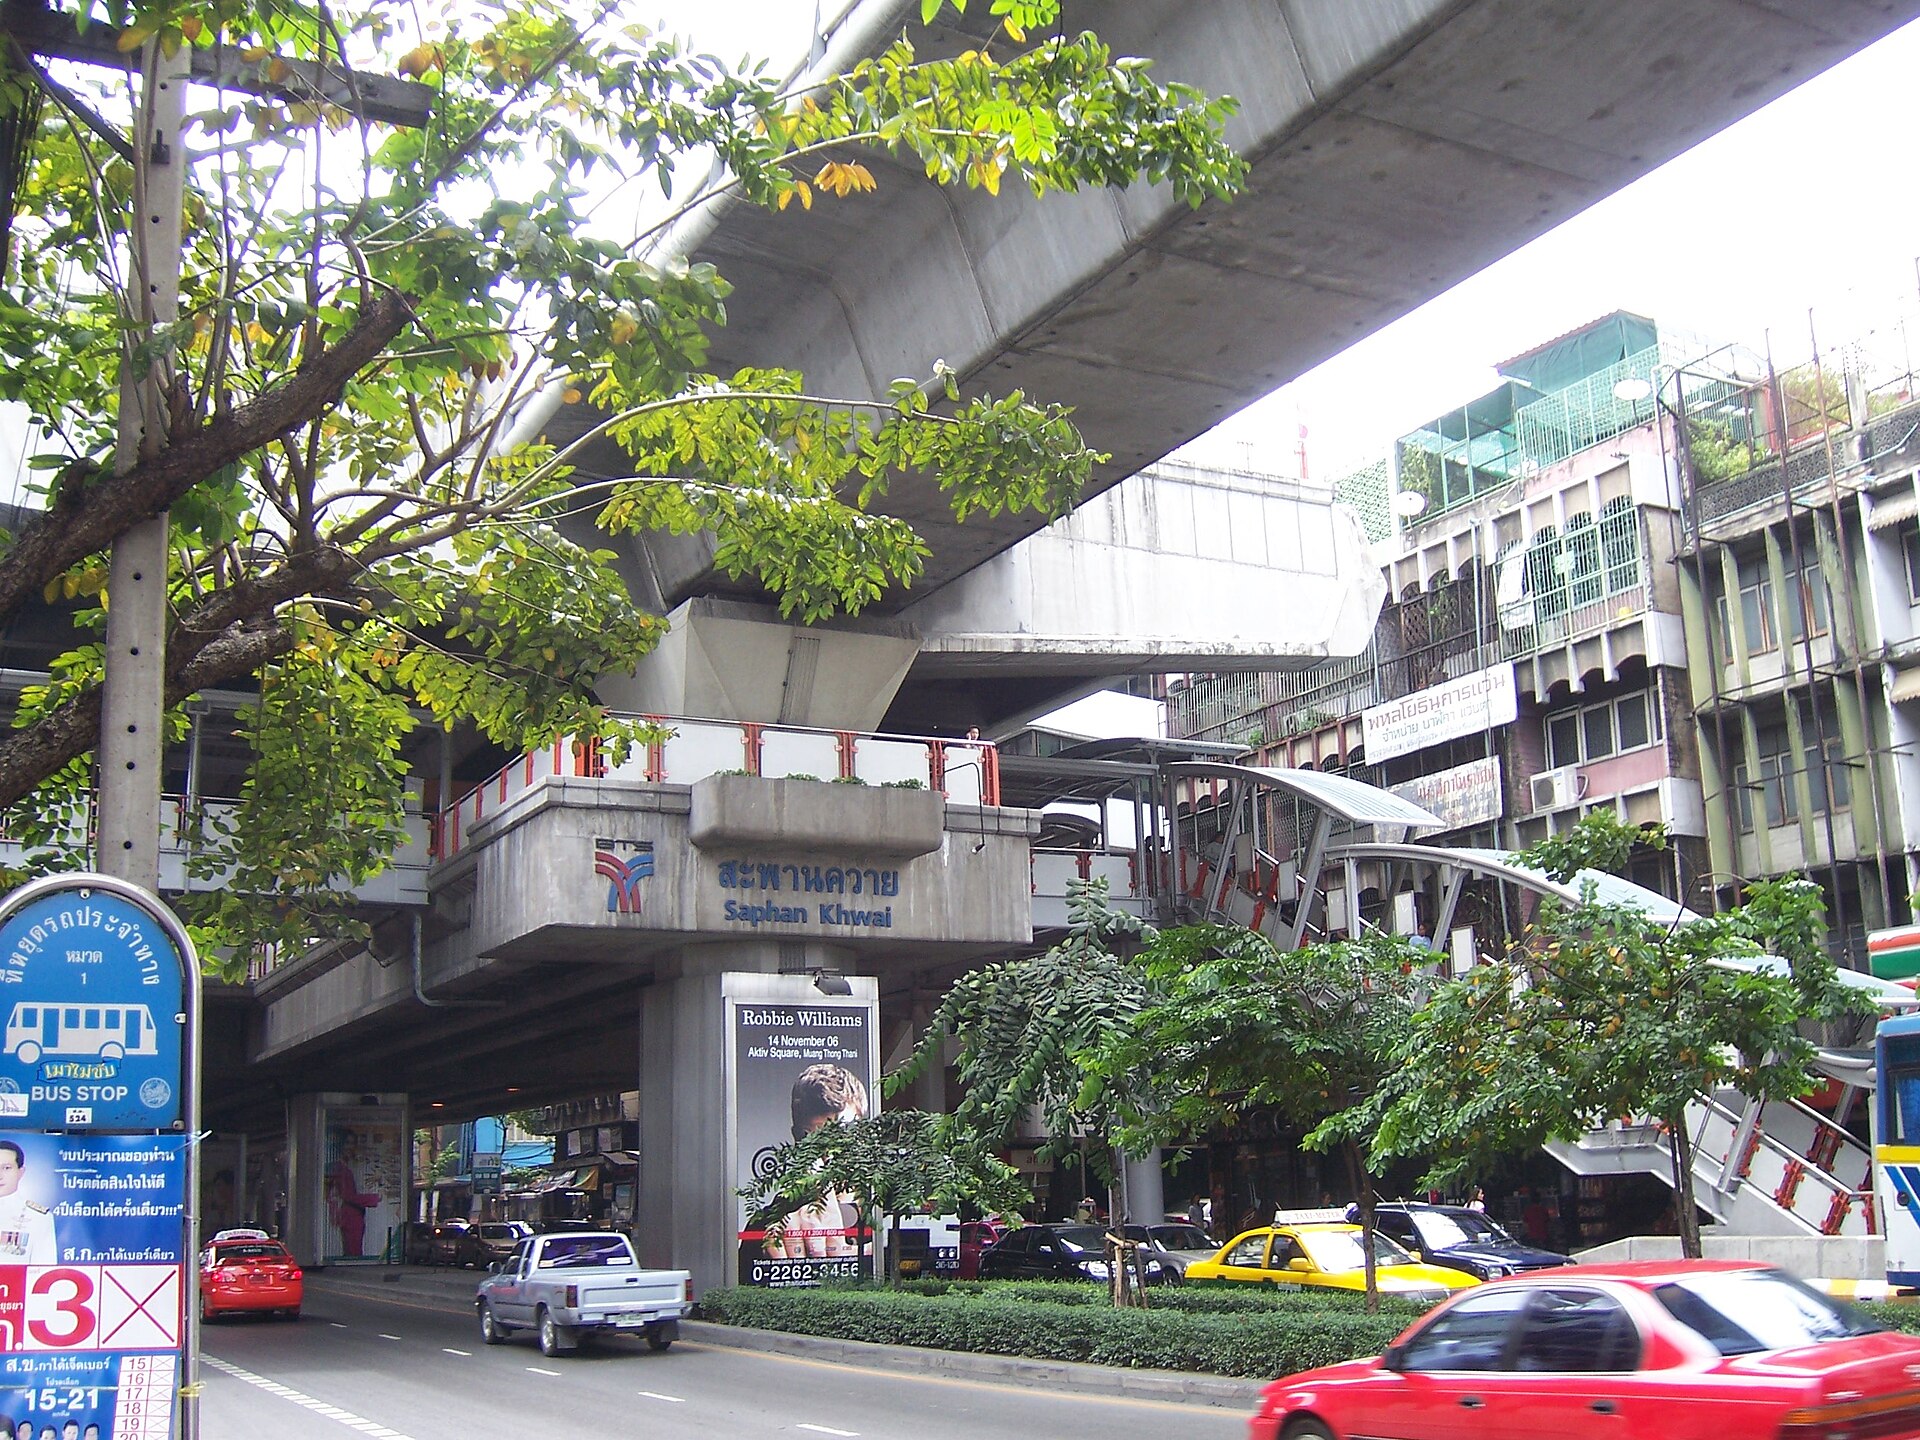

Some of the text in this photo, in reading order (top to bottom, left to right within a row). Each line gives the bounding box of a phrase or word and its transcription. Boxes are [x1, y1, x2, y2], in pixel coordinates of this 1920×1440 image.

[1382, 722, 1419, 743] จำหน่าย
[596, 838, 654, 852] BTS
[718, 857, 900, 897] สะพานควาย
[724, 899, 893, 928] Saphan Khwai
[66, 950, 103, 963] หมวด
[80, 972, 87, 985] 1
[742, 1010, 863, 1027] Robbie Williams
[768, 1035, 839, 1047] 14 November 06
[748, 1046, 858, 1060] Aktiv Square, Muang Thong Thani
[44, 1062, 116, 1080] เมาไม่ขับ
[31, 1086, 128, 1102] BUS STOP
[68, 1114, 87, 1123] 524
[63, 1173, 165, 1190] โปรดตัดสินใจให้ดี
[753, 1262, 859, 1281] 0-2262-3456
[28, 1268, 96, 1347] 3
[128, 1357, 146, 1370] 15
[127, 1373, 144, 1385] 16
[24, 1388, 99, 1411] 15-21
[125, 1387, 143, 1400] 17
[123, 1402, 141, 1415] 18
[122, 1417, 140, 1431] 19
